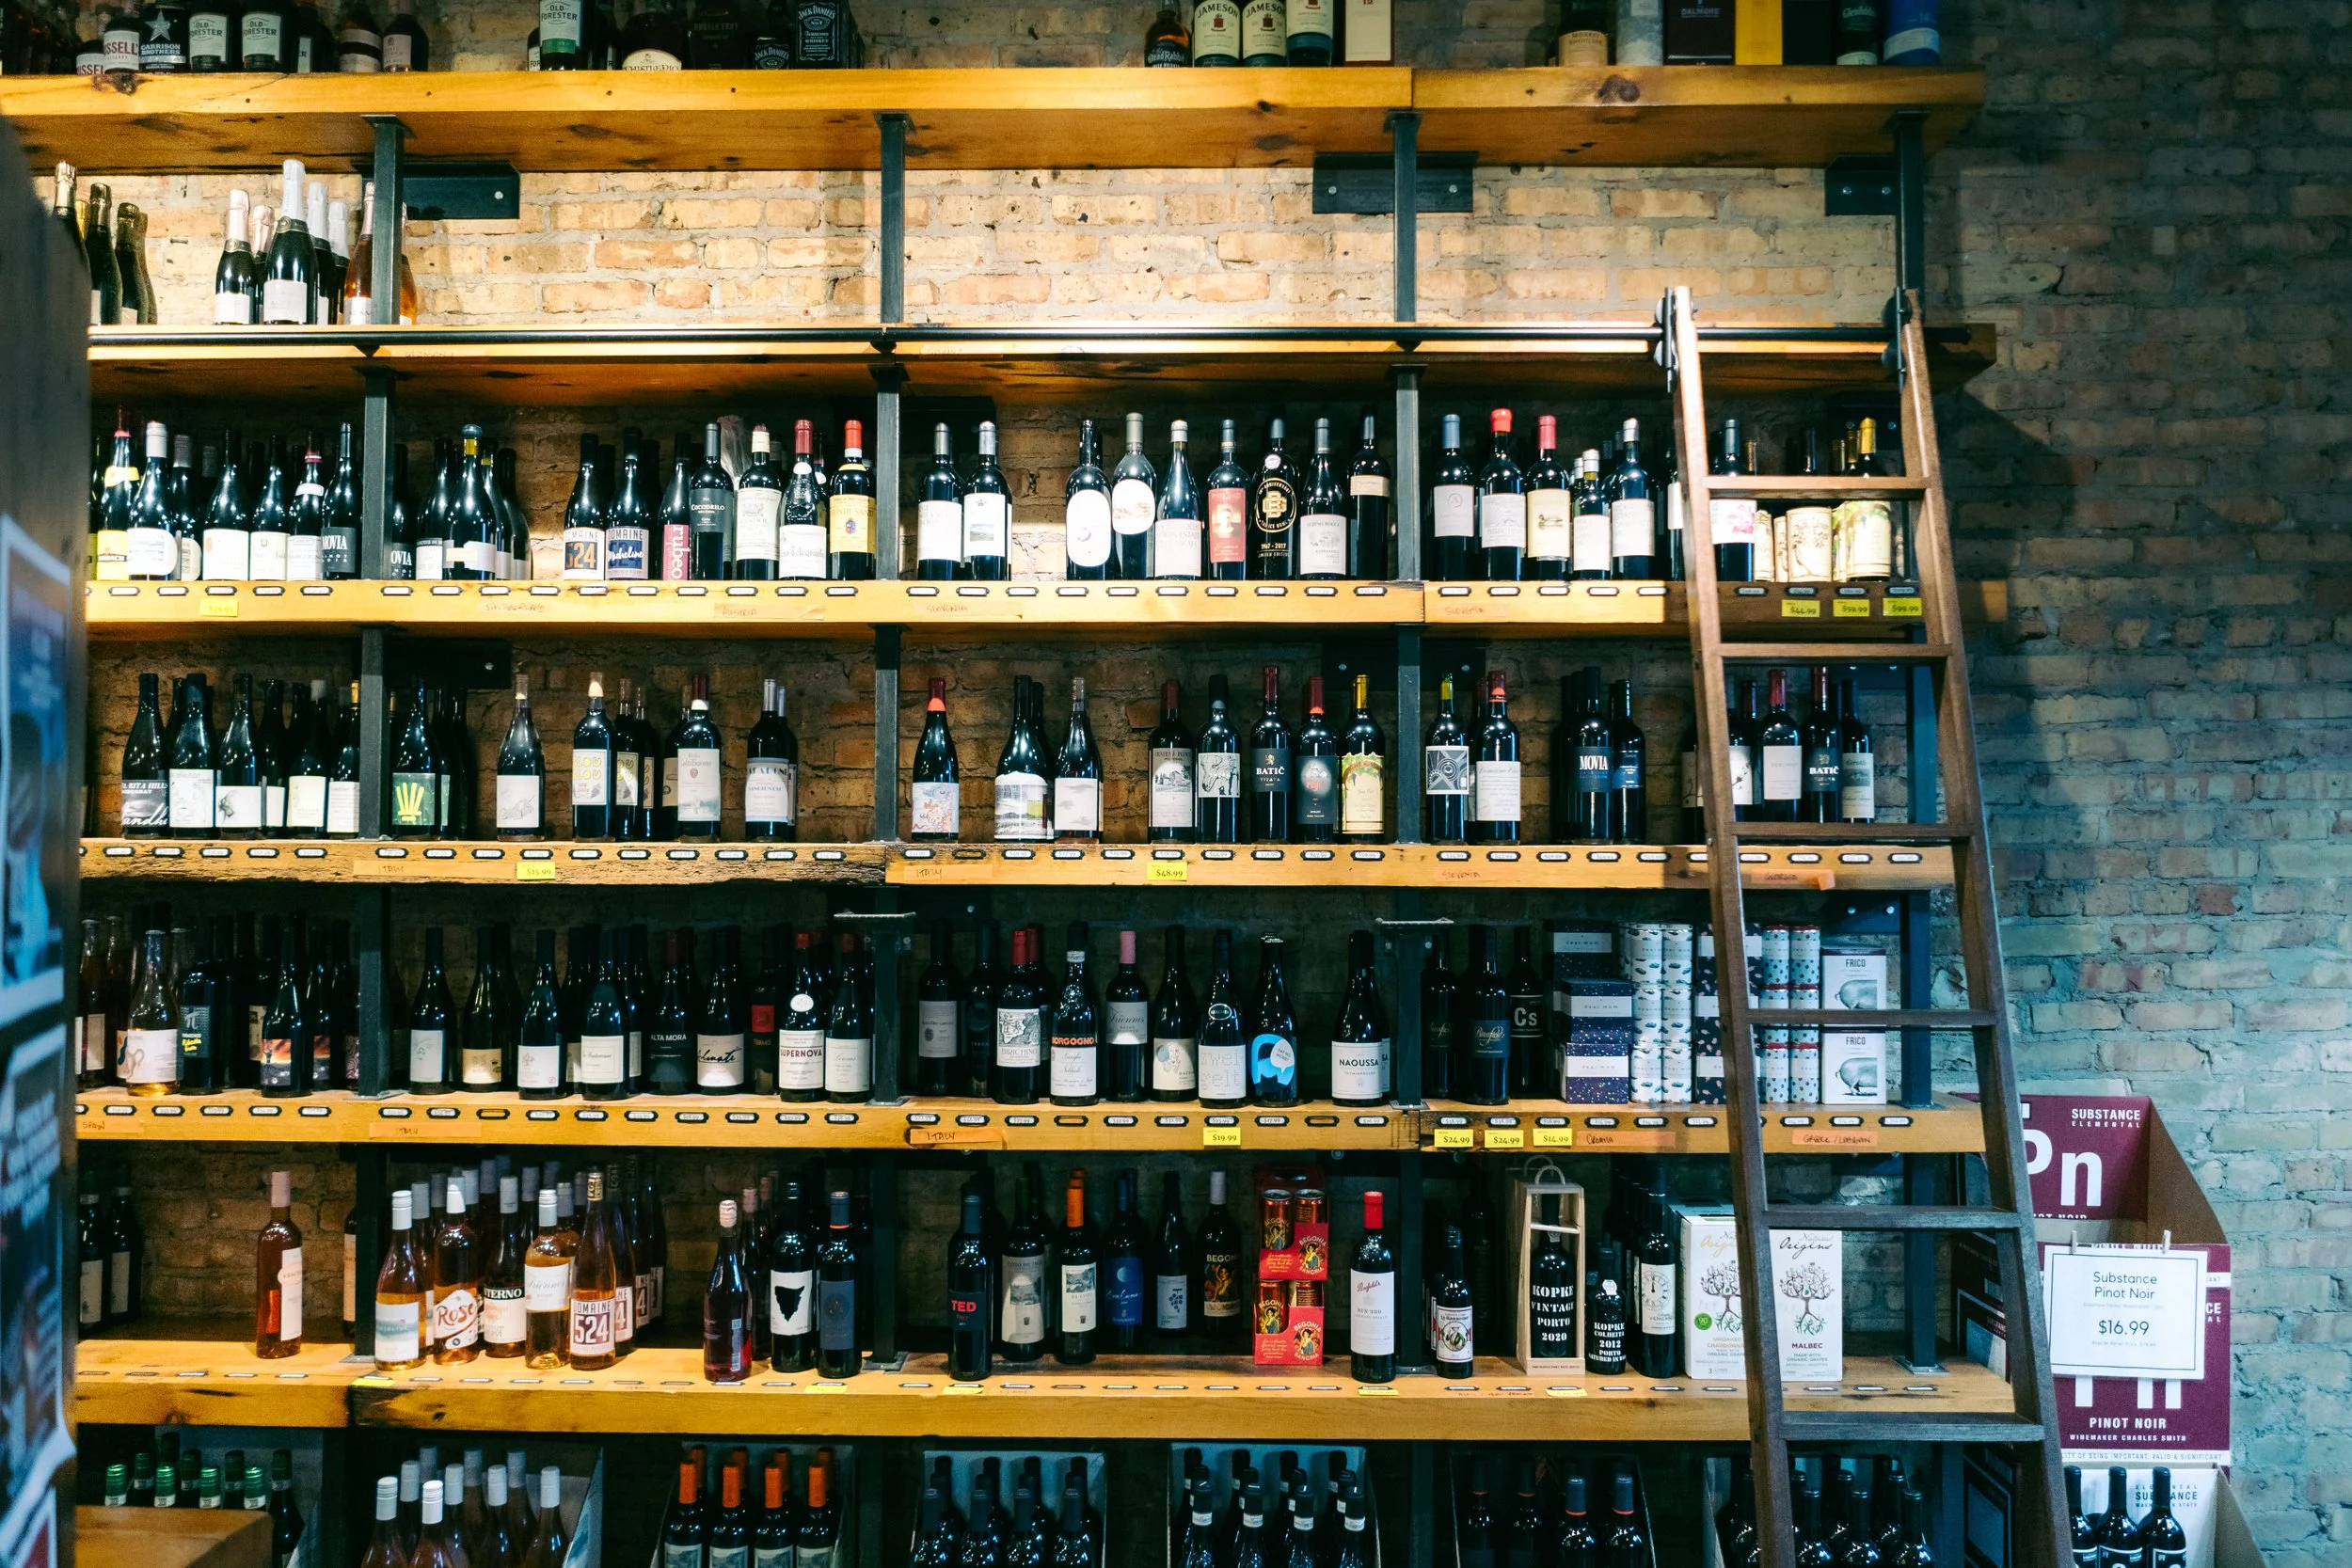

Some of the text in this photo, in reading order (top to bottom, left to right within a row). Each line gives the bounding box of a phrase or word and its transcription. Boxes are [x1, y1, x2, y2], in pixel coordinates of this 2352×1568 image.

[540, 11, 578, 21] FORESTER
[798, 5, 836, 20] JACK DANIEL'S
[1196, 4, 1240, 19] JAMESON
[755, 50, 789, 61] JACK DANIEL'S
[1263, 482, 1291, 494] ANNIVERSARY
[691, 503, 725, 512] COCODRILO
[672, 524, 691, 579] rubeo
[390, 550, 412, 566] OVIA
[926, 604, 968, 613] SLOVENIA
[1891, 606, 1919, 614] $99.99
[1579, 755, 1609, 770] MOVIA
[1255, 766, 1285, 775] BATIČ
[1809, 766, 1840, 775] BATIČ
[916, 868, 942, 879] ITALY
[1156, 869, 1184, 878] $48.99
[1845, 958, 1866, 968] FRICO
[1514, 1007, 1538, 1026] Cs
[1051, 1037, 1095, 1046] BORGOGNO
[1845, 1036, 1866, 1046] FRICO
[779, 1049, 823, 1058] SUPERNOVA
[1339, 1059, 1380, 1067] NAOUSSA
[2071, 1108, 2140, 1120] SUBSTANCE
[926, 1132, 956, 1141] ITALY
[1212, 1133, 1237, 1142] $19.99
[1443, 1135, 1470, 1144] $24.99
[1493, 1136, 1520, 1145] $24.99
[1543, 1135, 1569, 1143] $14.99
[2023, 1129, 2103, 1207] Pn
[1299, 1235, 1327, 1247] BEGONIA
[1780, 1236, 1833, 1259] Origins
[1299, 1265, 1324, 1276] SANGRIA
[2093, 1271, 2158, 1284] Substance
[1532, 1284, 1574, 1298] KOPKE
[2094, 1286, 2156, 1299] Pinot Noir
[951, 1299, 977, 1313] TED
[1293, 1321, 1322, 1332] BEGONIA
[1537, 1317, 1571, 1328] PORTO
[1594, 1322, 1625, 1331] KOPKE
[2098, 1319, 2150, 1336] $16.99
[574, 1314, 609, 1344] 524
[1541, 1332, 1568, 1342] 2020
[1599, 1340, 1621, 1348] 2012
[1294, 1351, 1320, 1362] SANGRIA
[2089, 1417, 2167, 1429] PINOT NOIR
